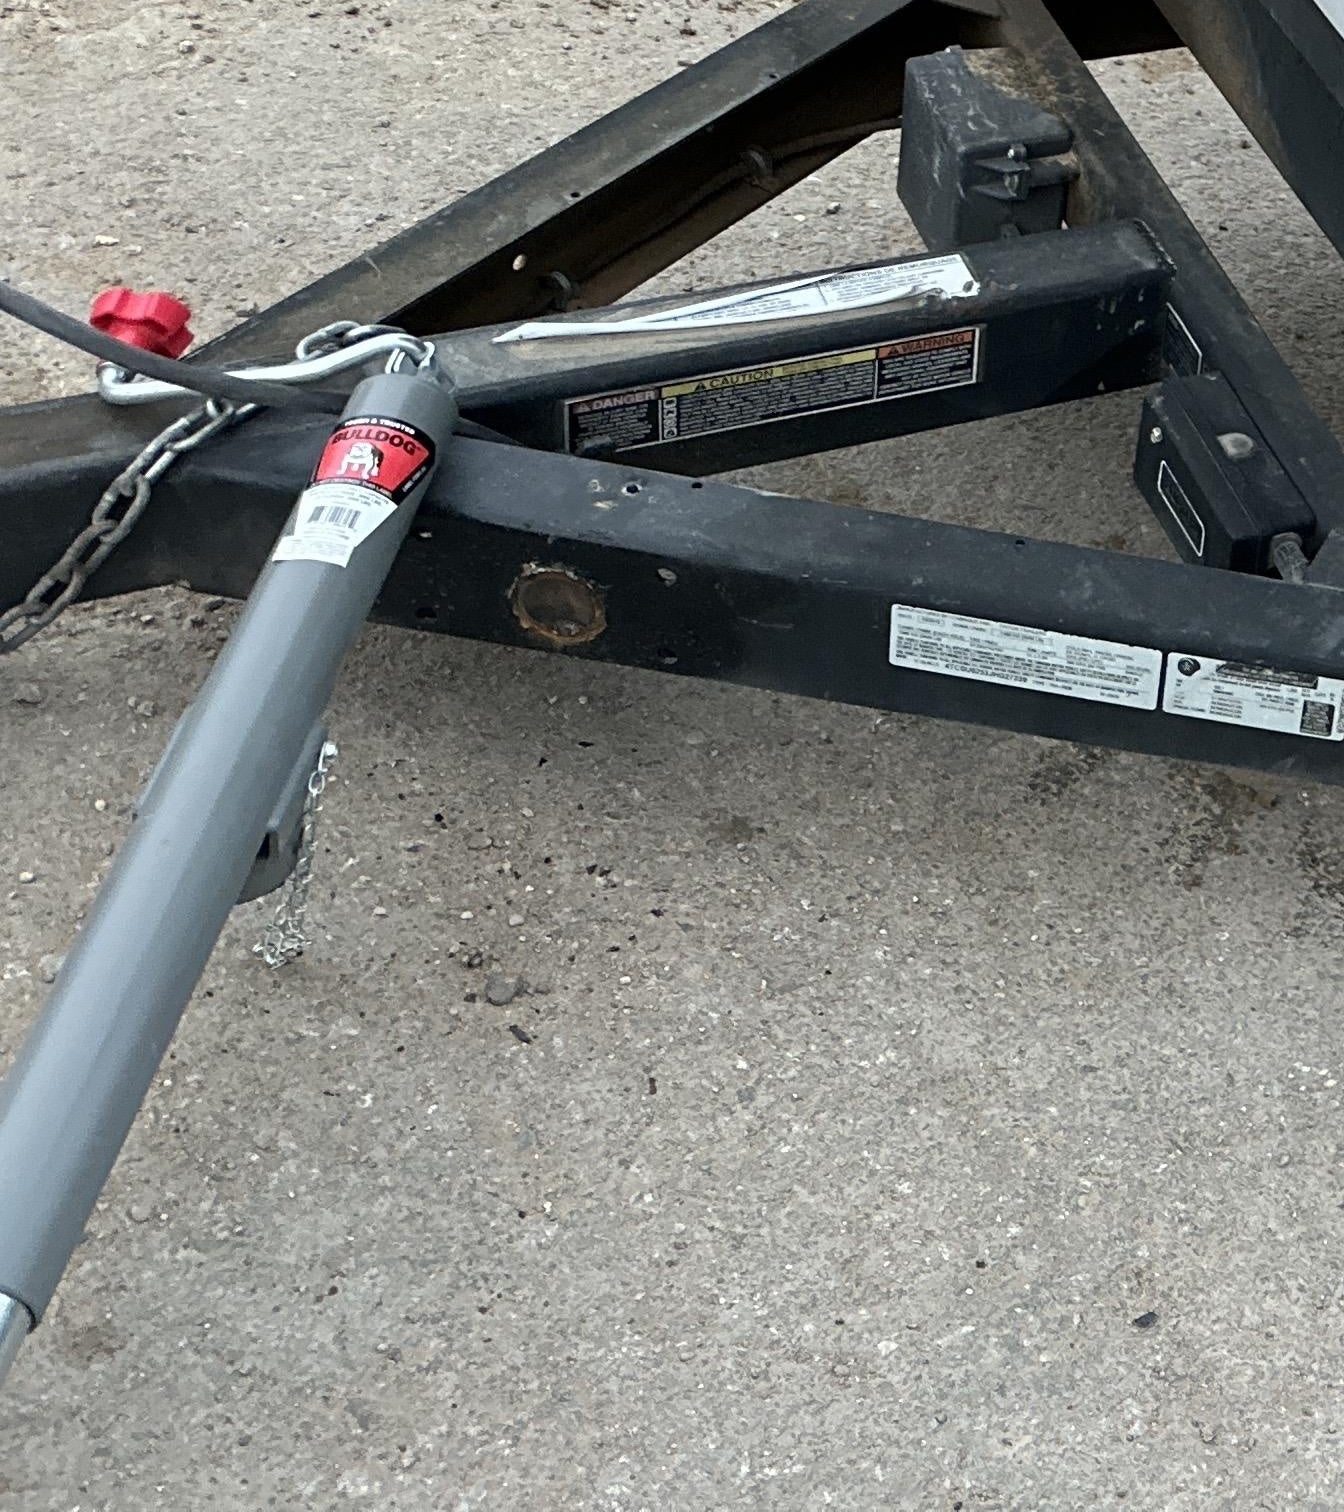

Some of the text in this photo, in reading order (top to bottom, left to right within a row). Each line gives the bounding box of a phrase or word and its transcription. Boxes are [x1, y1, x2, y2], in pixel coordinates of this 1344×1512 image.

[901, 333, 964, 352] WARNING
[709, 368, 774, 388] CAUTION
[592, 390, 656, 410] DANGER
[331, 428, 417, 456] BULLDOG
